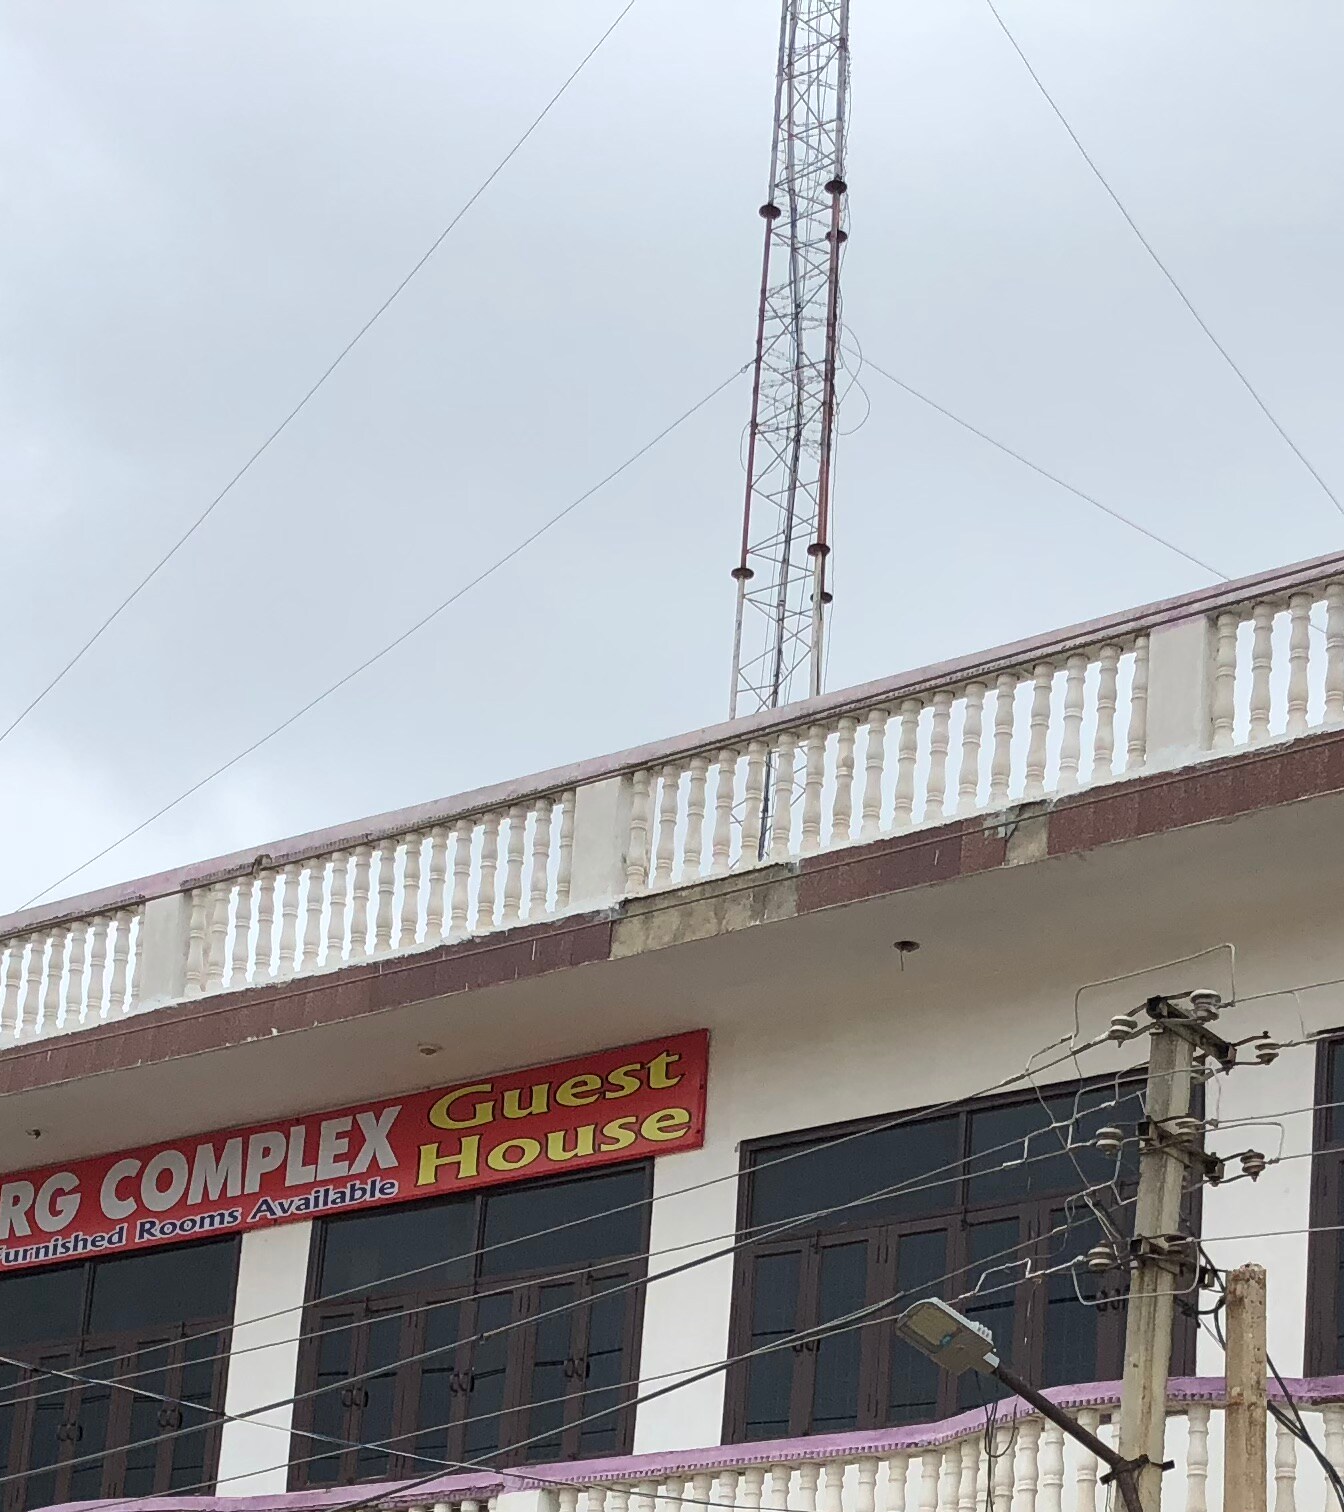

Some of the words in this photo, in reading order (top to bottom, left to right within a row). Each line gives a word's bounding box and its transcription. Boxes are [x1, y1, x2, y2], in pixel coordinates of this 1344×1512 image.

[426, 1050, 684, 1132] Guest
[100, 1105, 402, 1212] COMPLEX
[415, 1106, 692, 1188] House
[136, 1206, 240, 1242] Rooms
[248, 1176, 398, 1223] Available
